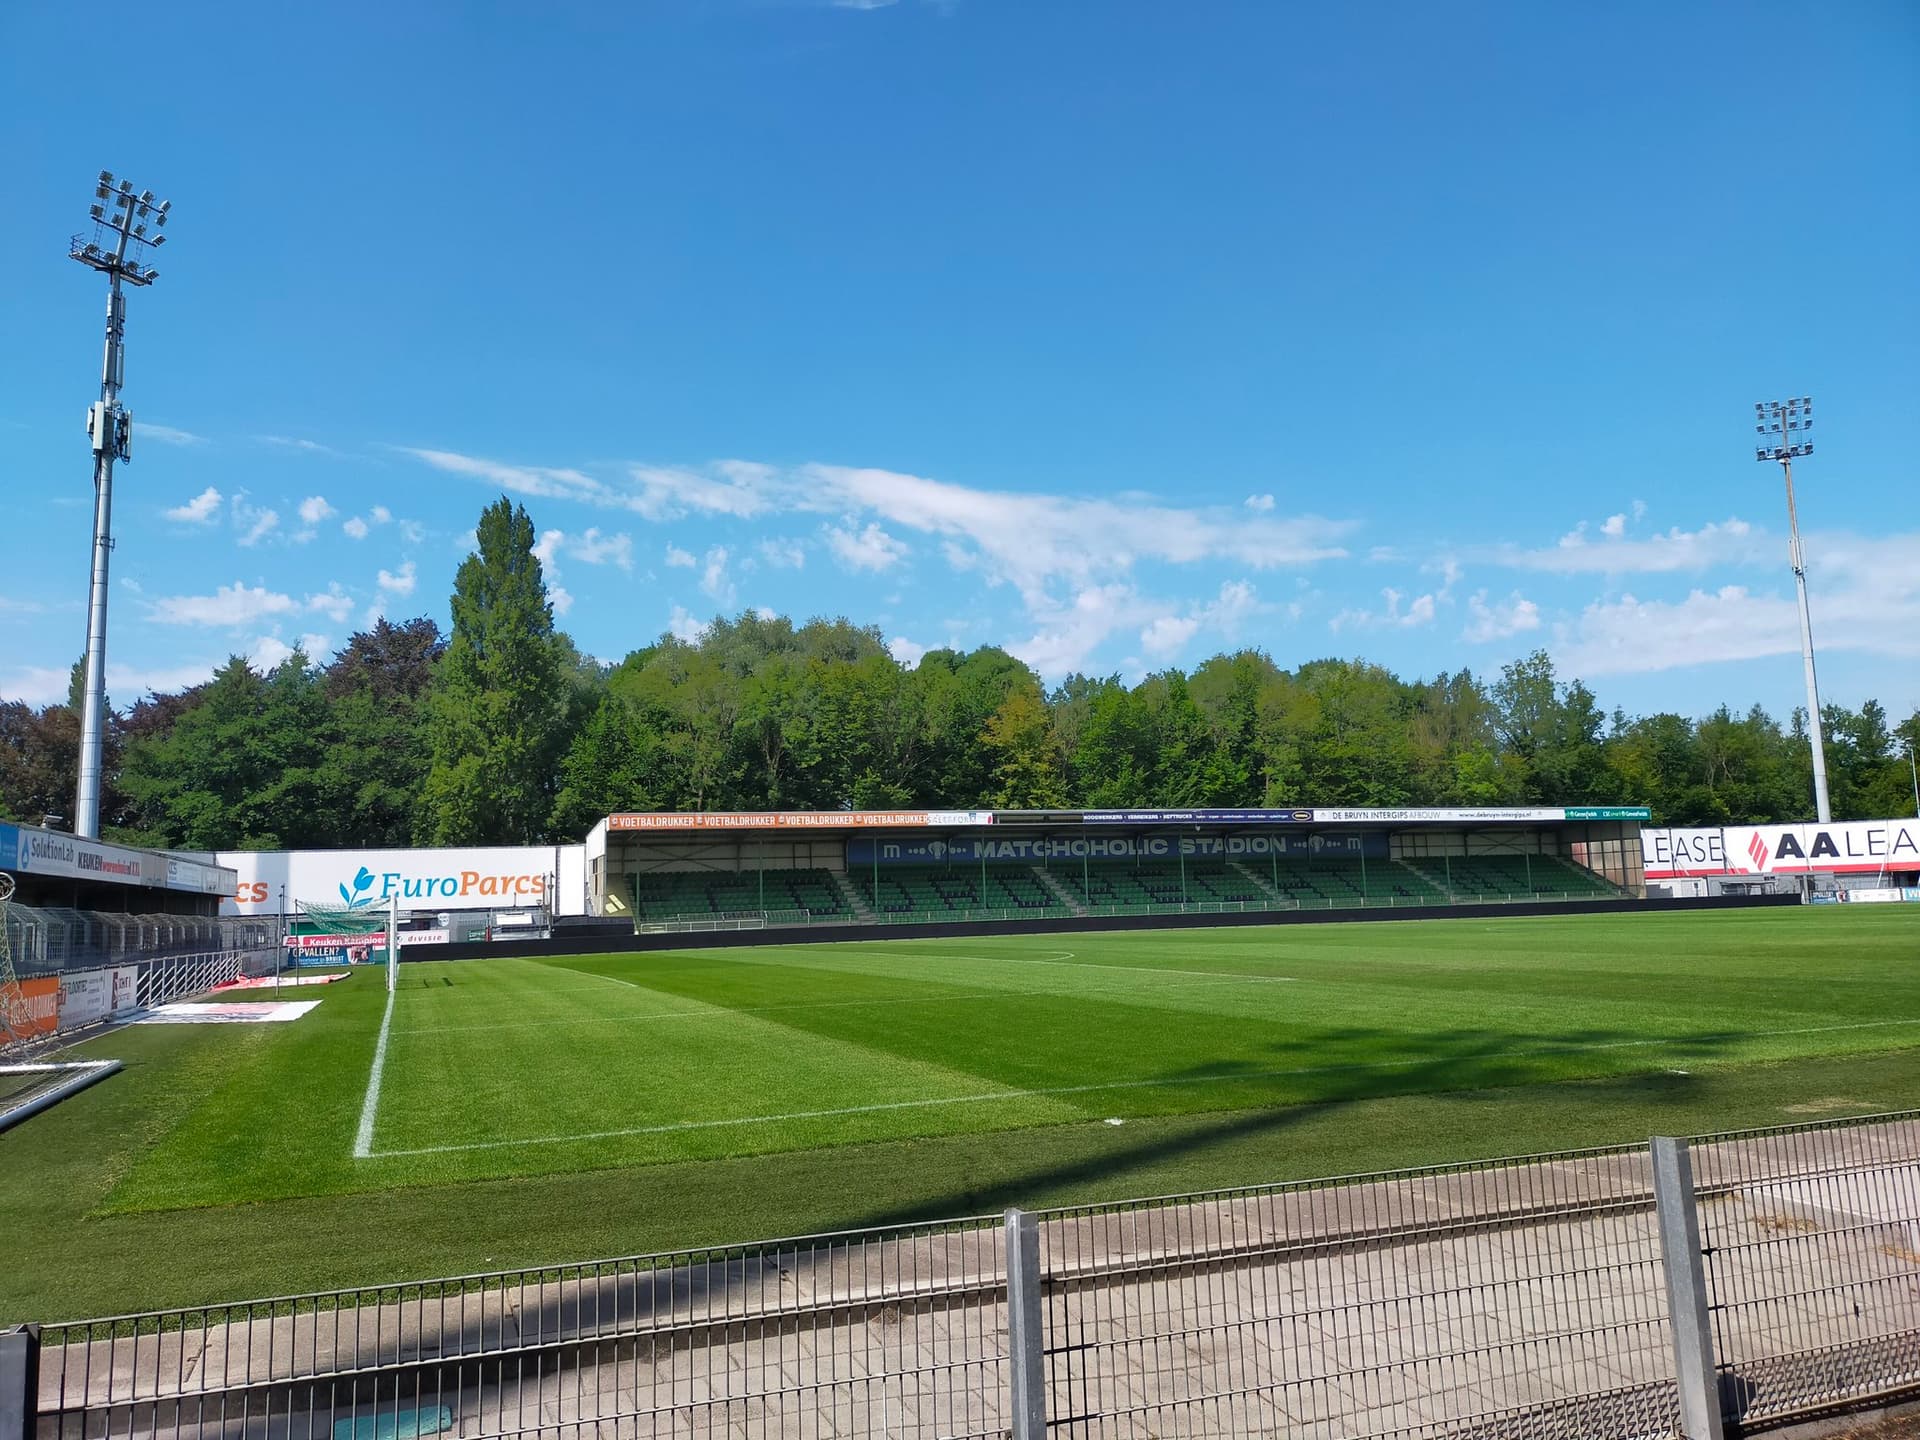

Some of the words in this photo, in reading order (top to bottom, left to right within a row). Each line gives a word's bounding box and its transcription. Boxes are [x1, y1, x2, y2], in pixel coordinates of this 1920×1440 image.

[619, 816, 695, 827] VOETBALDRUKKER
[704, 816, 775, 826] VOETBALDRUKKER
[785, 815, 854, 825] VOETBALDRUKKER
[863, 814, 928, 824] VOETBALDRUKKER
[1332, 811, 1342, 819] DE
[1344, 811, 1369, 819] BRUYN
[1371, 811, 1409, 819] INTERGIPS
[974, 839, 1169, 858] MATCHOHOLIC
[1178, 837, 1287, 854] STADION
[1641, 836, 1723, 863] LEASE
[380, 870, 546, 899] EuroParcs
[309, 936, 344, 947] Keuken
